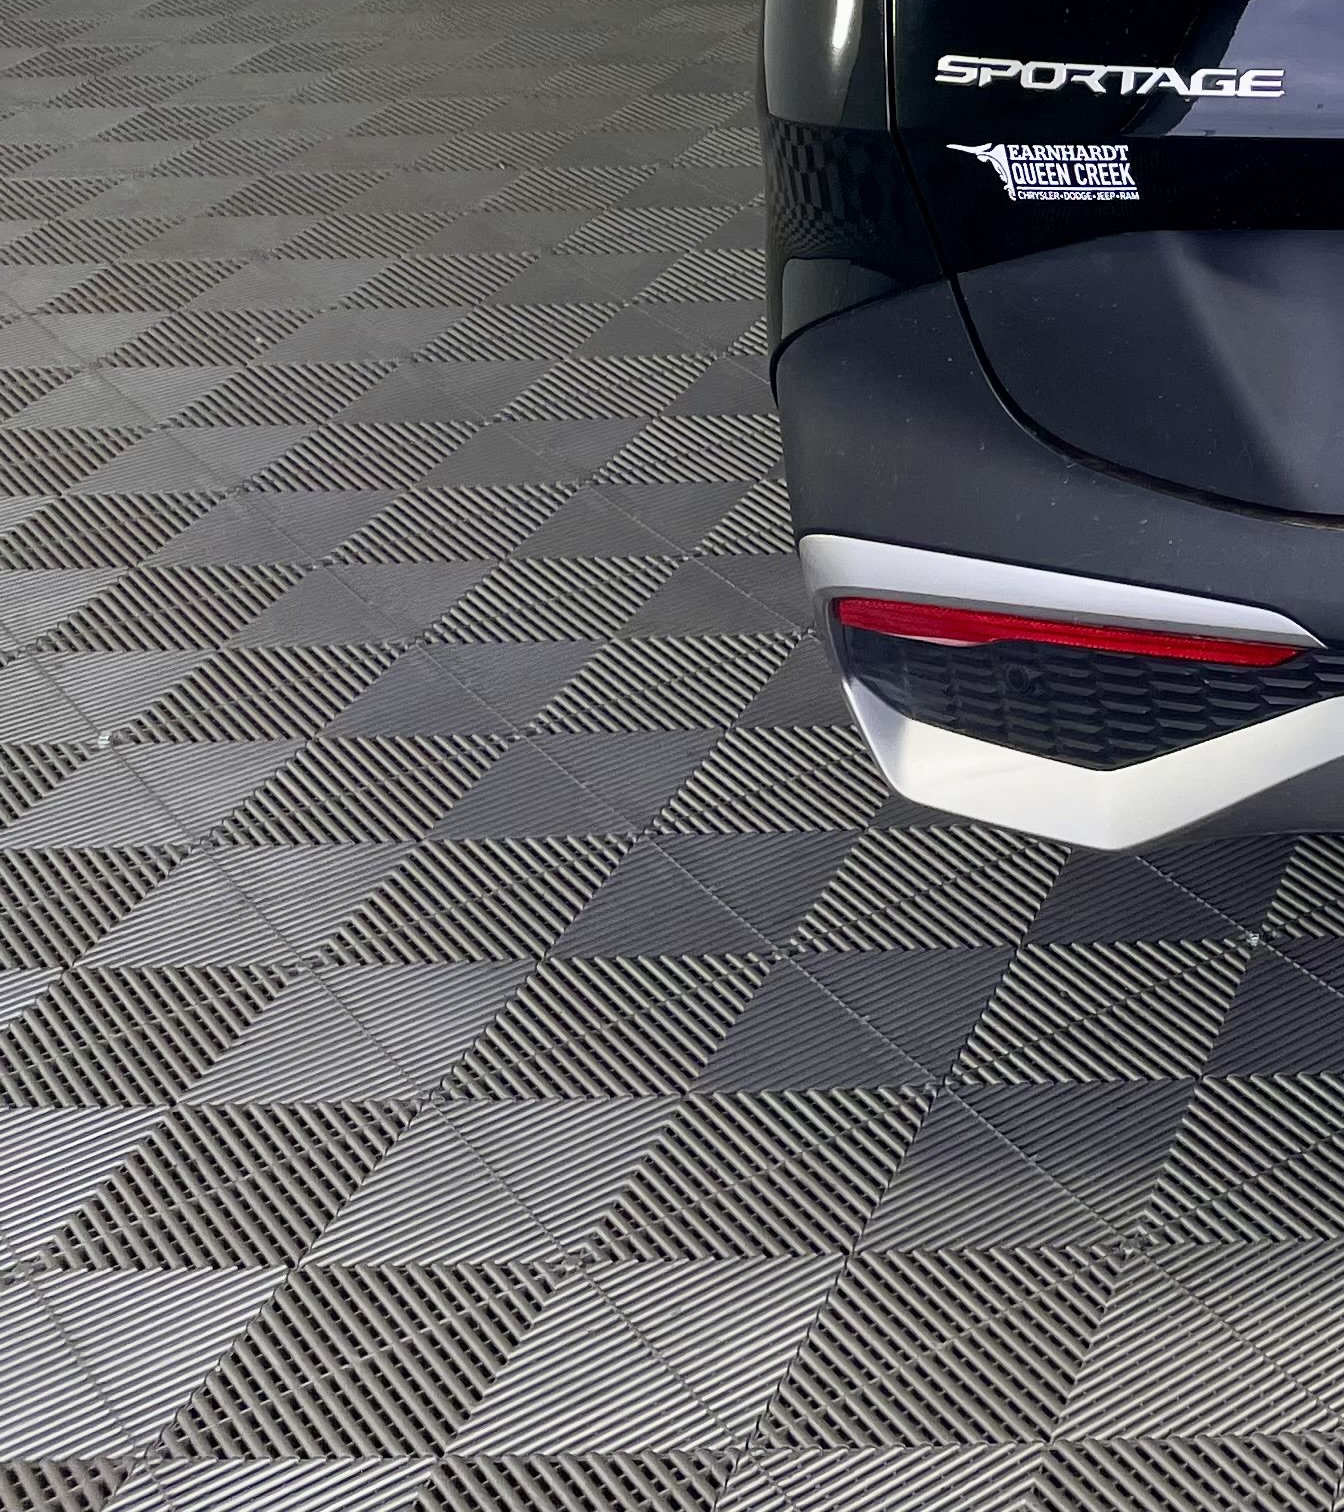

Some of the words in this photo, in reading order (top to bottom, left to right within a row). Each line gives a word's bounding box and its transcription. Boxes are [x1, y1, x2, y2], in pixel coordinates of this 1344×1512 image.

[935, 55, 1285, 97] SPORTAGE
[1007, 145, 1128, 161] EARNHARDT
[1012, 163, 1071, 185] QUEEN
[1074, 163, 1135, 185] CREEK
[1018, 191, 1060, 200] CHRYSLER
[1064, 191, 1092, 200] DODGE
[1097, 191, 1116, 200] JEEP
[1120, 191, 1139, 200] RAM
